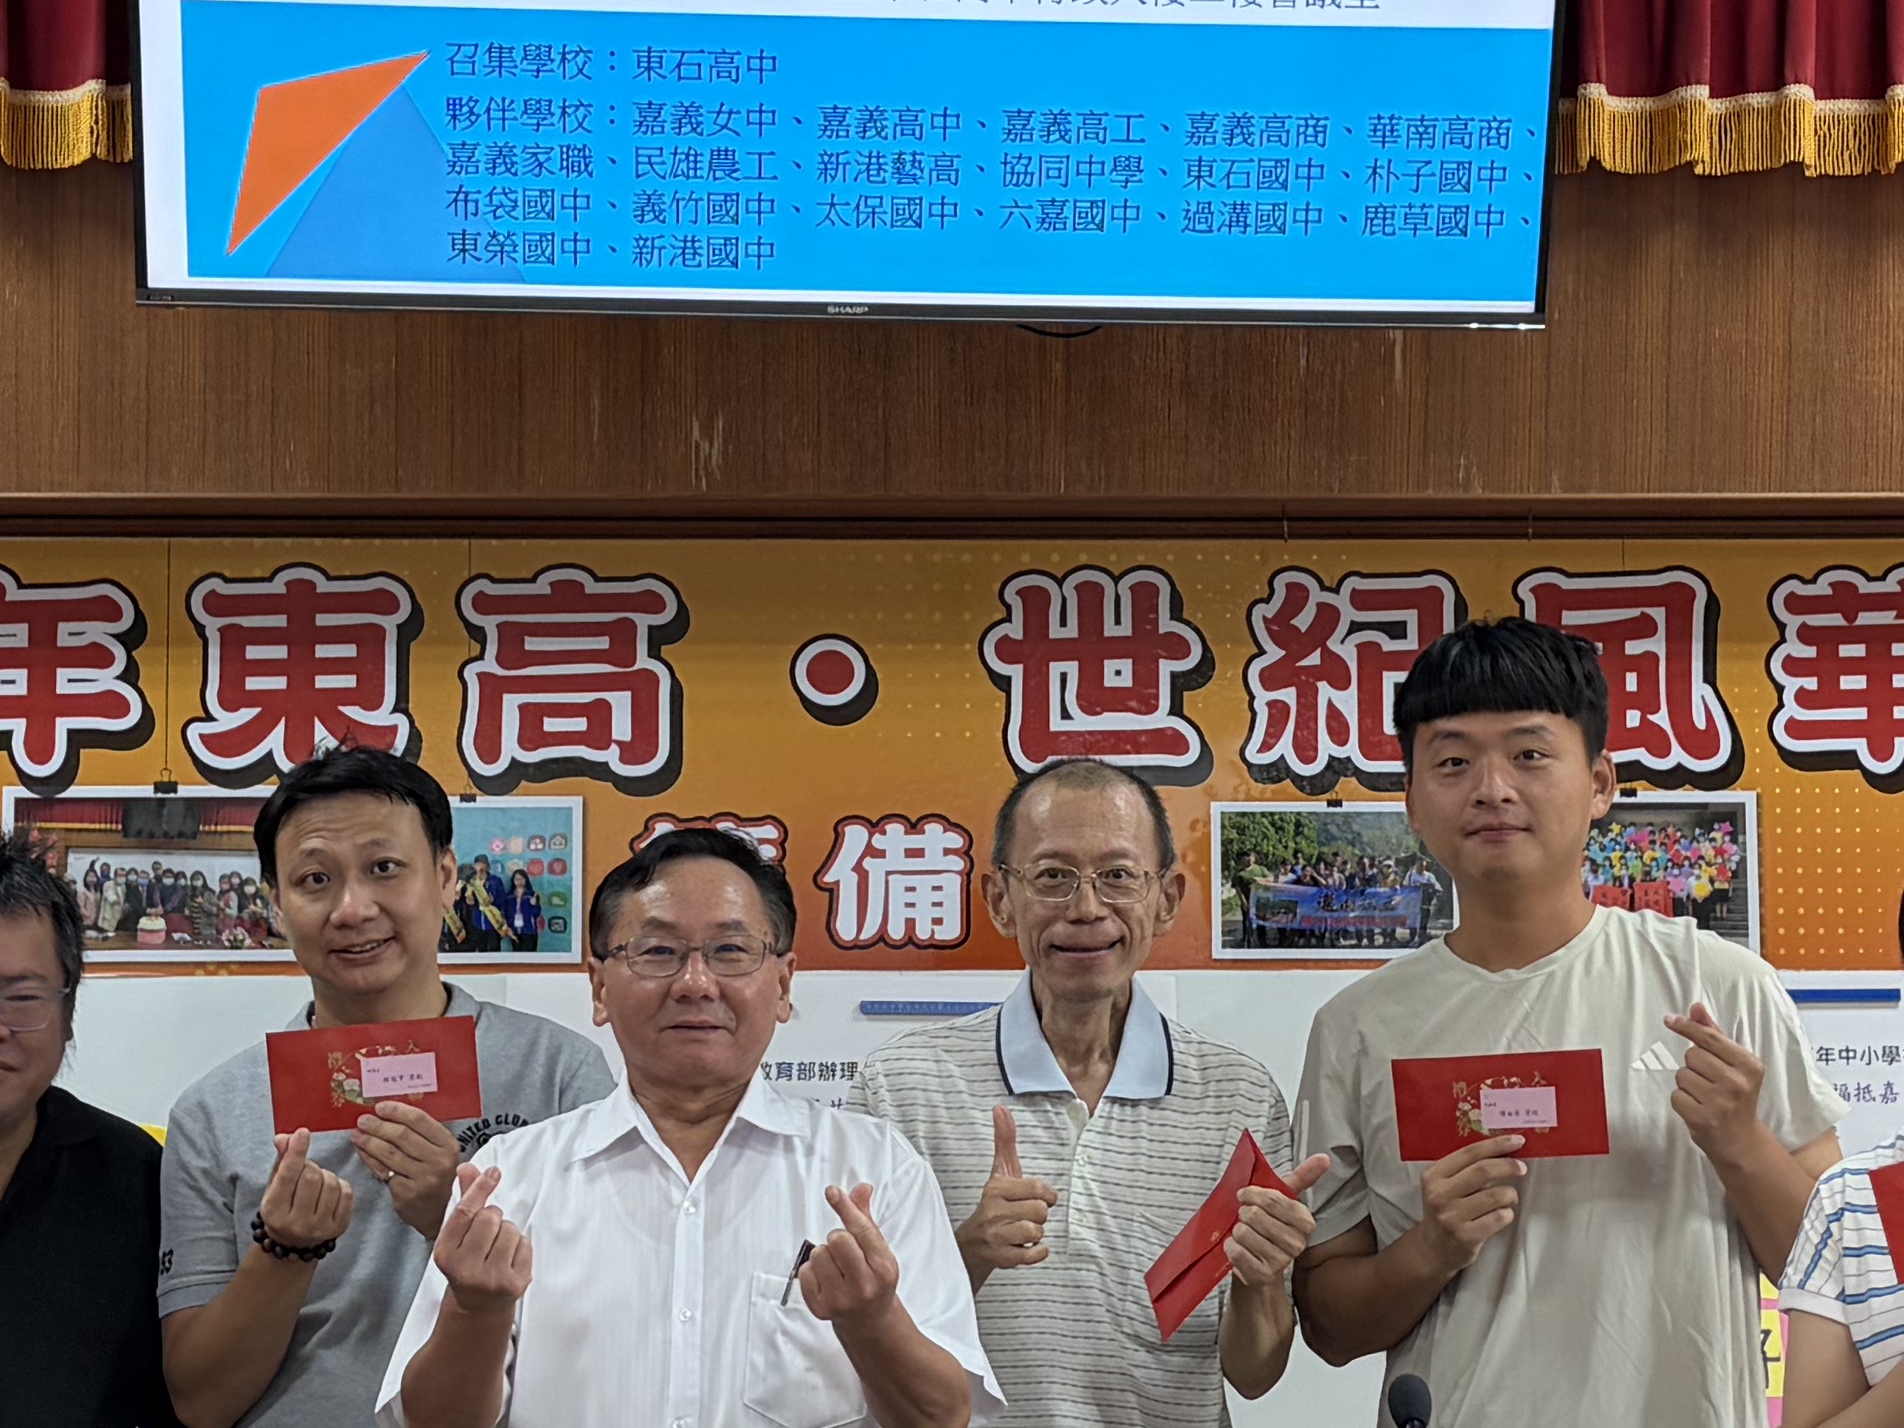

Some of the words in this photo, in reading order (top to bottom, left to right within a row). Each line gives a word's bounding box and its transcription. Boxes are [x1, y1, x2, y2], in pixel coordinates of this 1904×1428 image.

[445, 41, 778, 85] 召集學校：東石高中
[446, 229, 776, 271] 東榮國中、新港國中
[827, 305, 869, 314] SHARP
